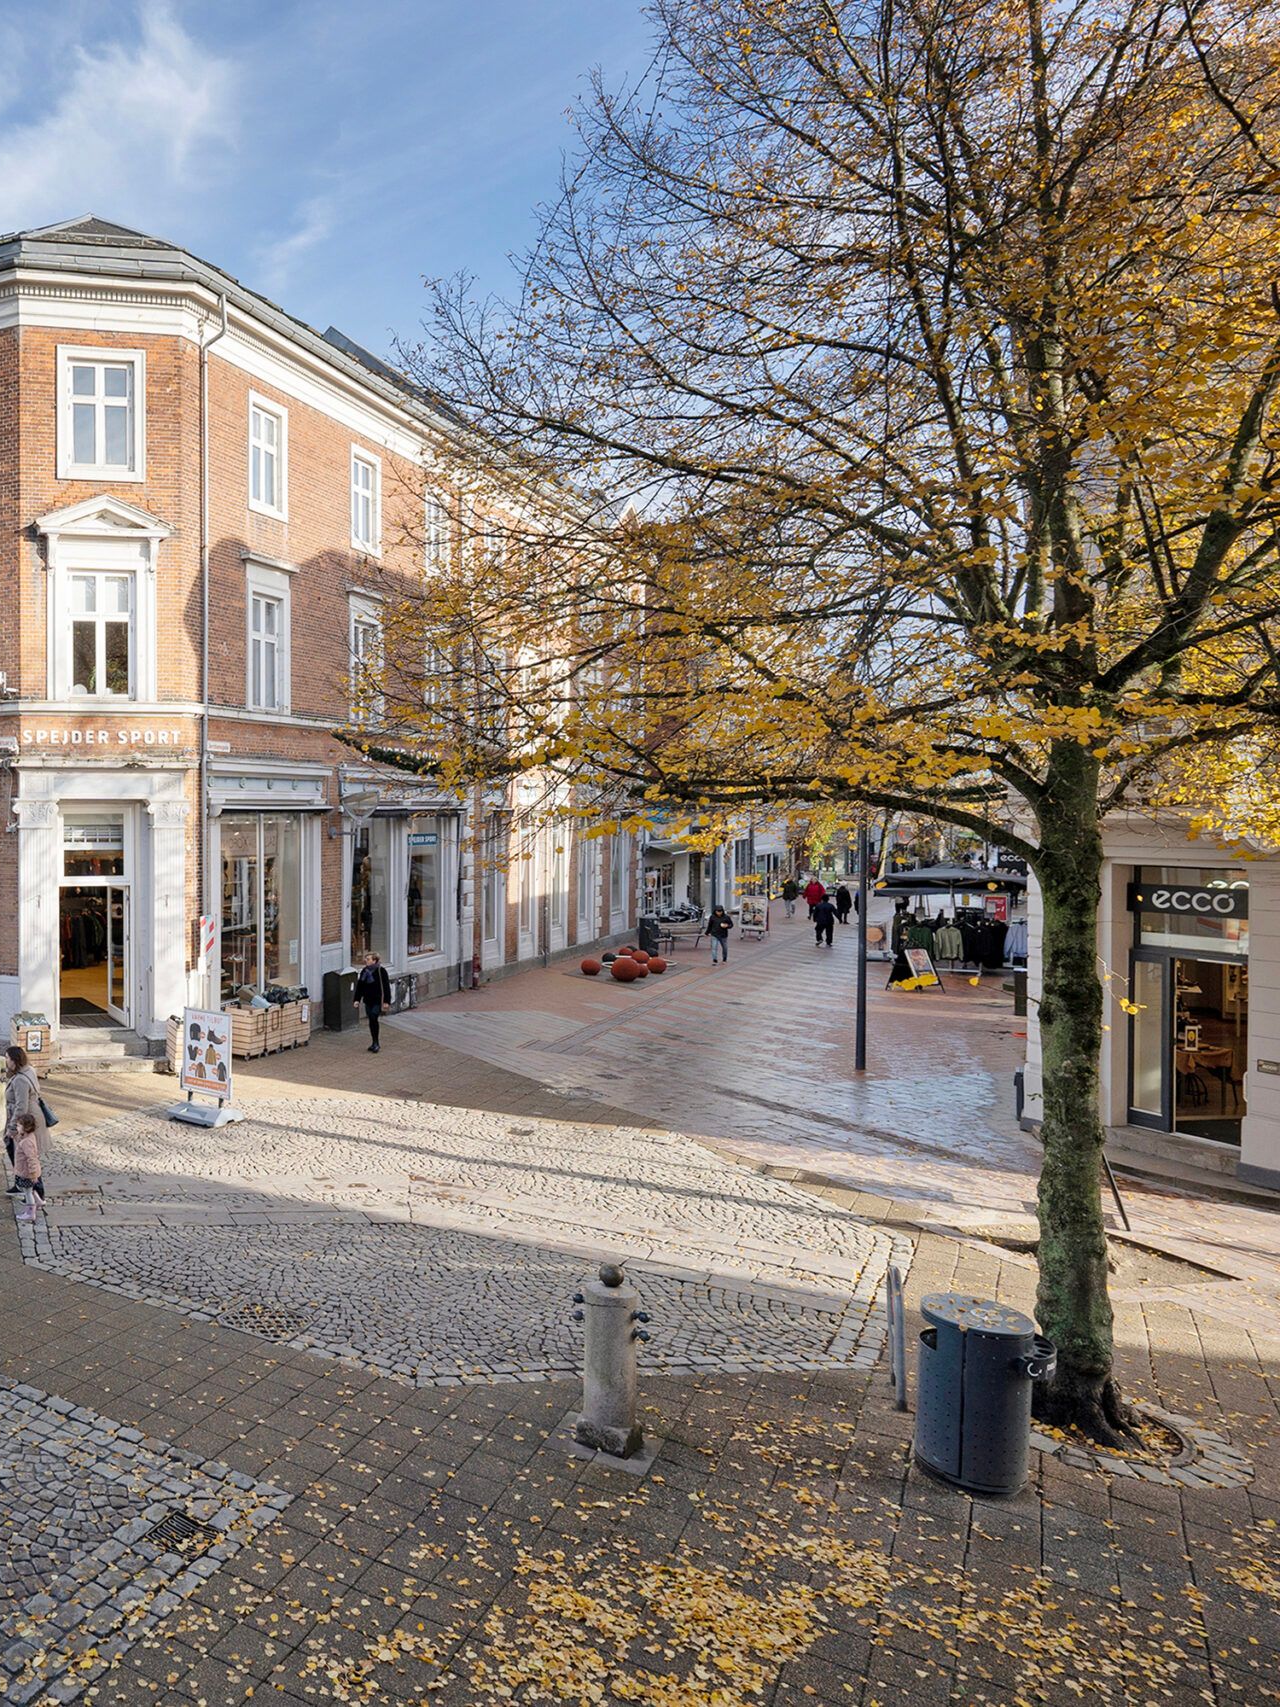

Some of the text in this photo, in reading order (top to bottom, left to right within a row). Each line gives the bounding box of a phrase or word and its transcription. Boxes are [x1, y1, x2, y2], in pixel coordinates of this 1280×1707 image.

[23, 729, 181, 745] SPEJDER SPORT
[1151, 890, 1236, 914] ecco
